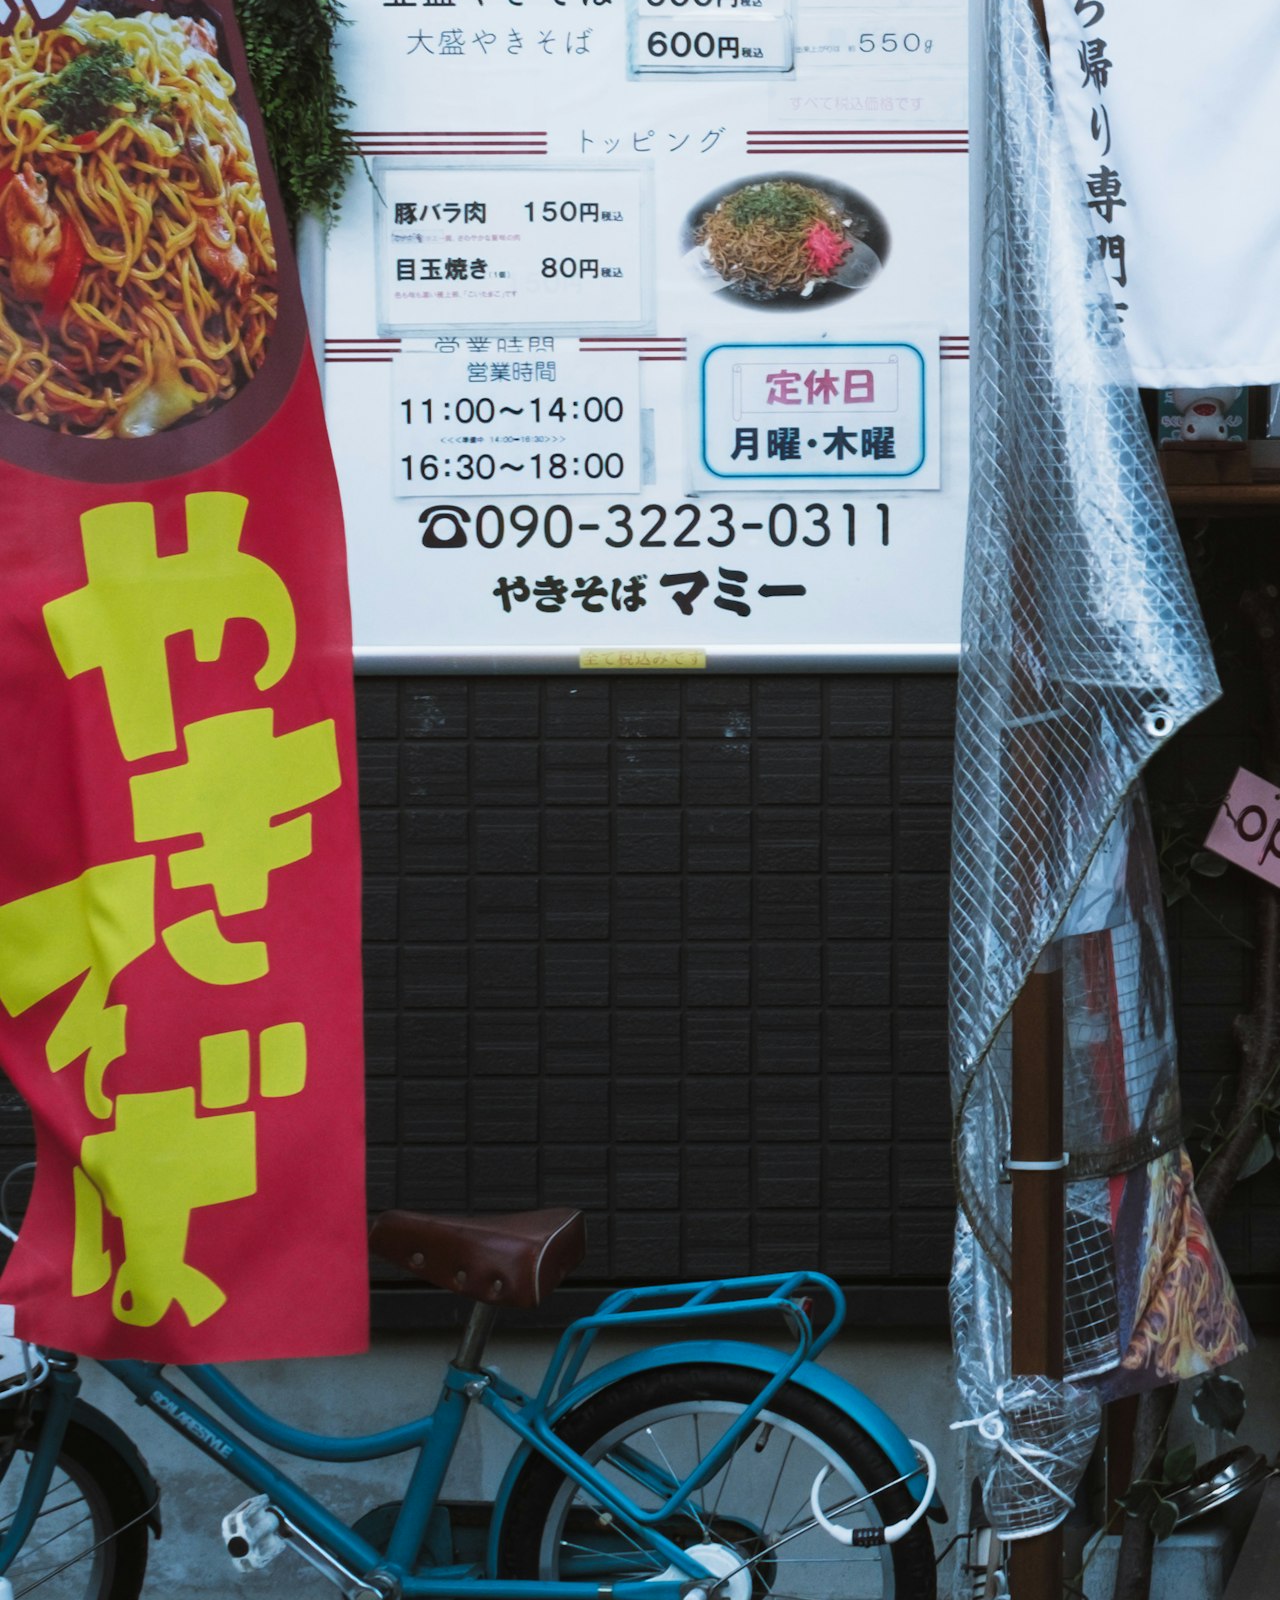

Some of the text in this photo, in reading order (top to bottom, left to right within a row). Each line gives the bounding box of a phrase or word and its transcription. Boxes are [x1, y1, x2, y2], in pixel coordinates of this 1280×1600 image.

[406, 27, 593, 57] 大盛やきそば
[859, 32, 933, 54] 550g
[580, 126, 727, 155] トッピング
[394, 202, 487, 225] 豚バラ肉
[468, 361, 557, 382] 営業時間
[765, 370, 875, 406] 定休日
[400, 396, 624, 425] 11:00～14:00
[731, 426, 896, 461] 月曜・木曜
[401, 452, 624, 481] 16:30～18:00
[474, 504, 891, 549] 090-3223-0311
[492, 567, 807, 618] やきそば マミー
[0, 491, 342, 1327] やきそば
